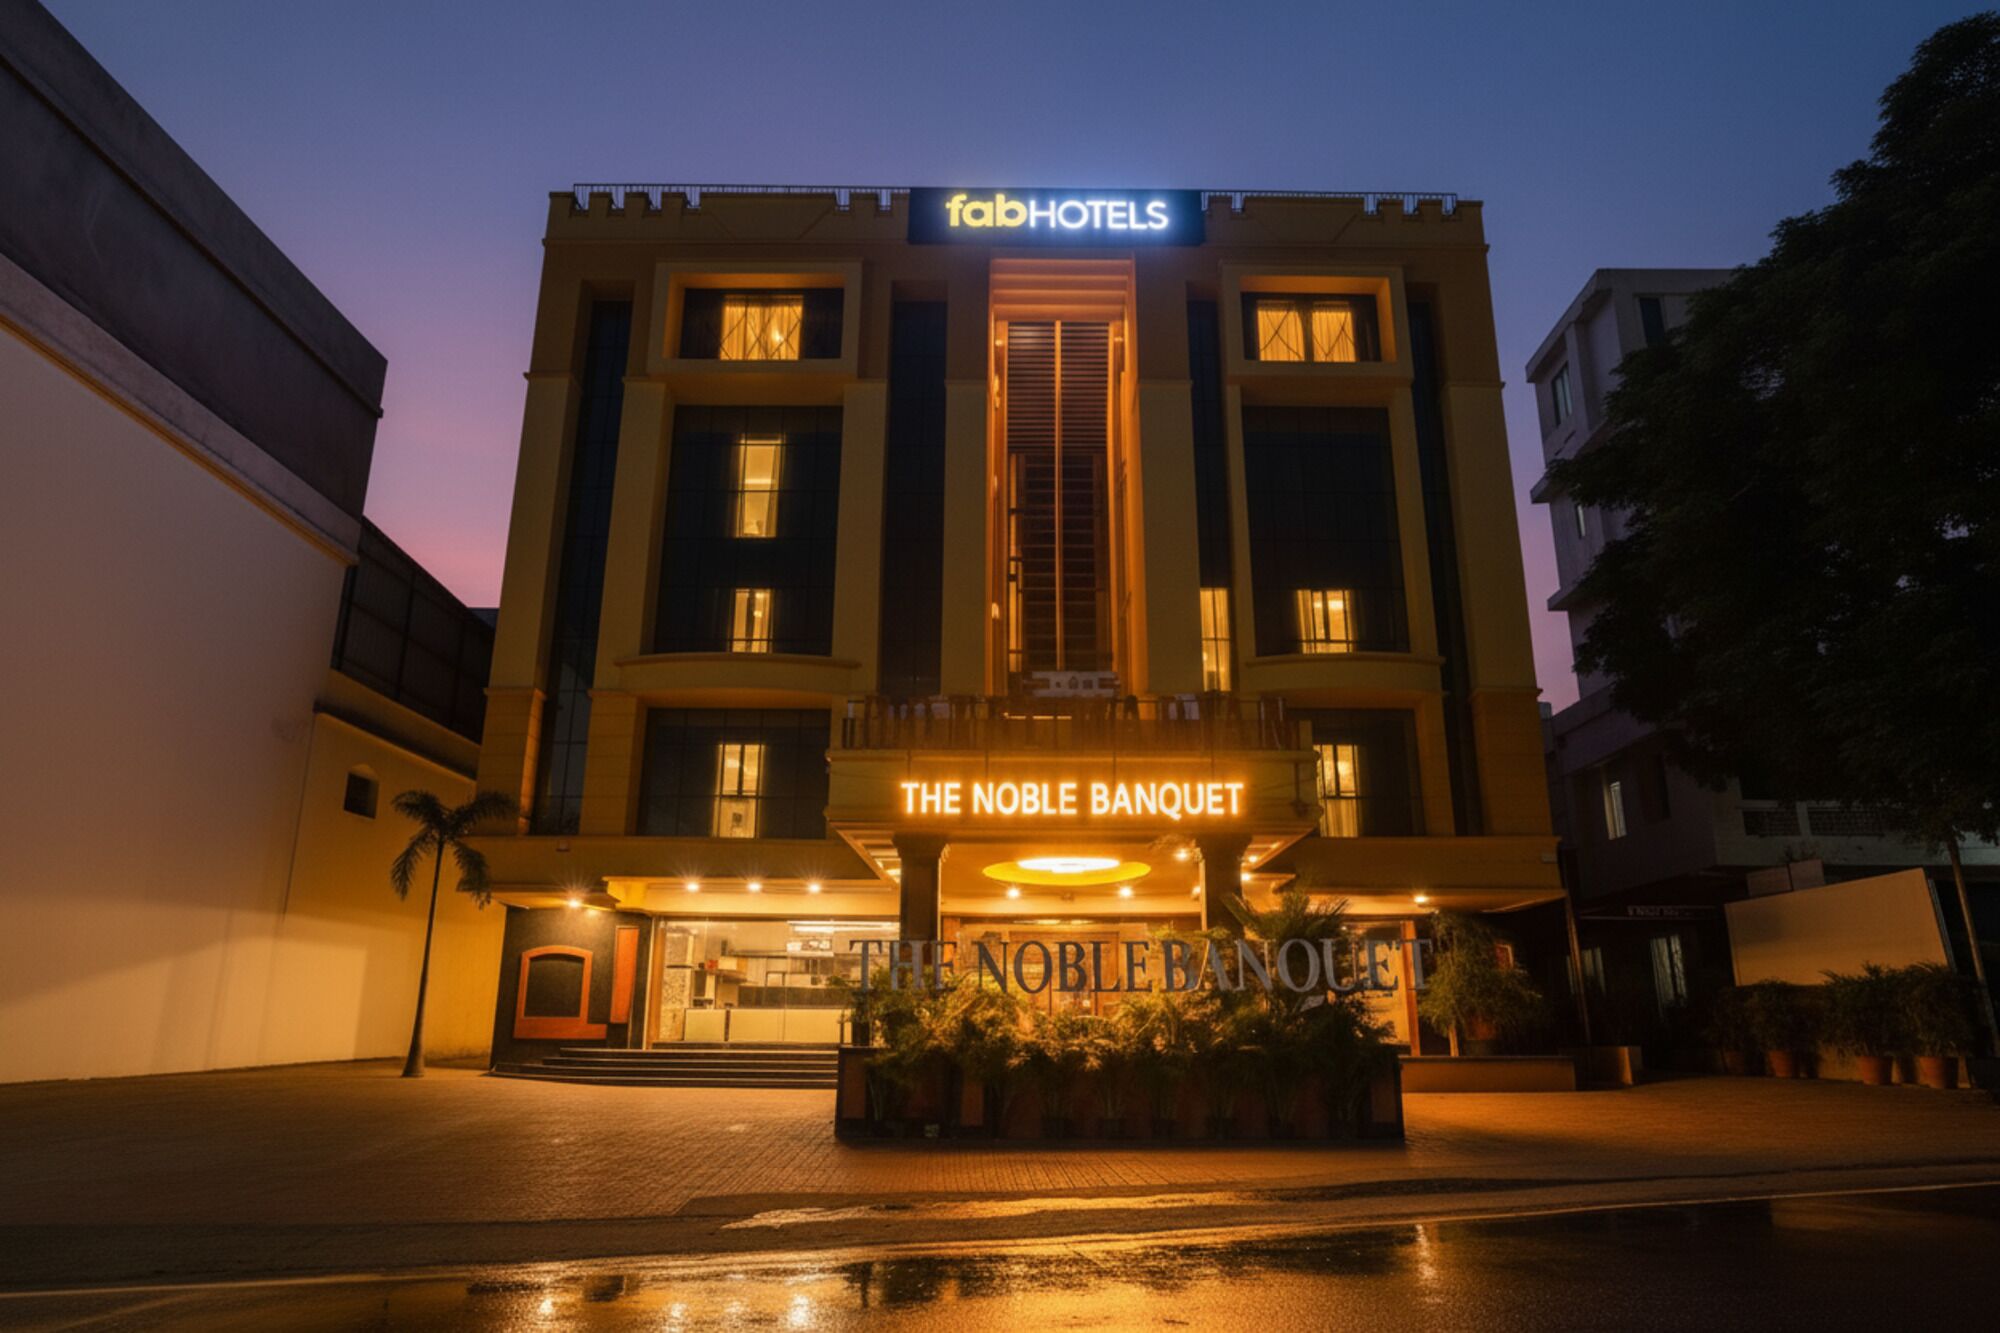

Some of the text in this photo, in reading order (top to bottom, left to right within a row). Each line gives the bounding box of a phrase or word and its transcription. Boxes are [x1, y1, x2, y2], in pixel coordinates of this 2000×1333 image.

[900, 781, 1244, 820] THE NOBLE BANQUET
[849, 938, 1434, 1013] THE NOBLE BANQUET
